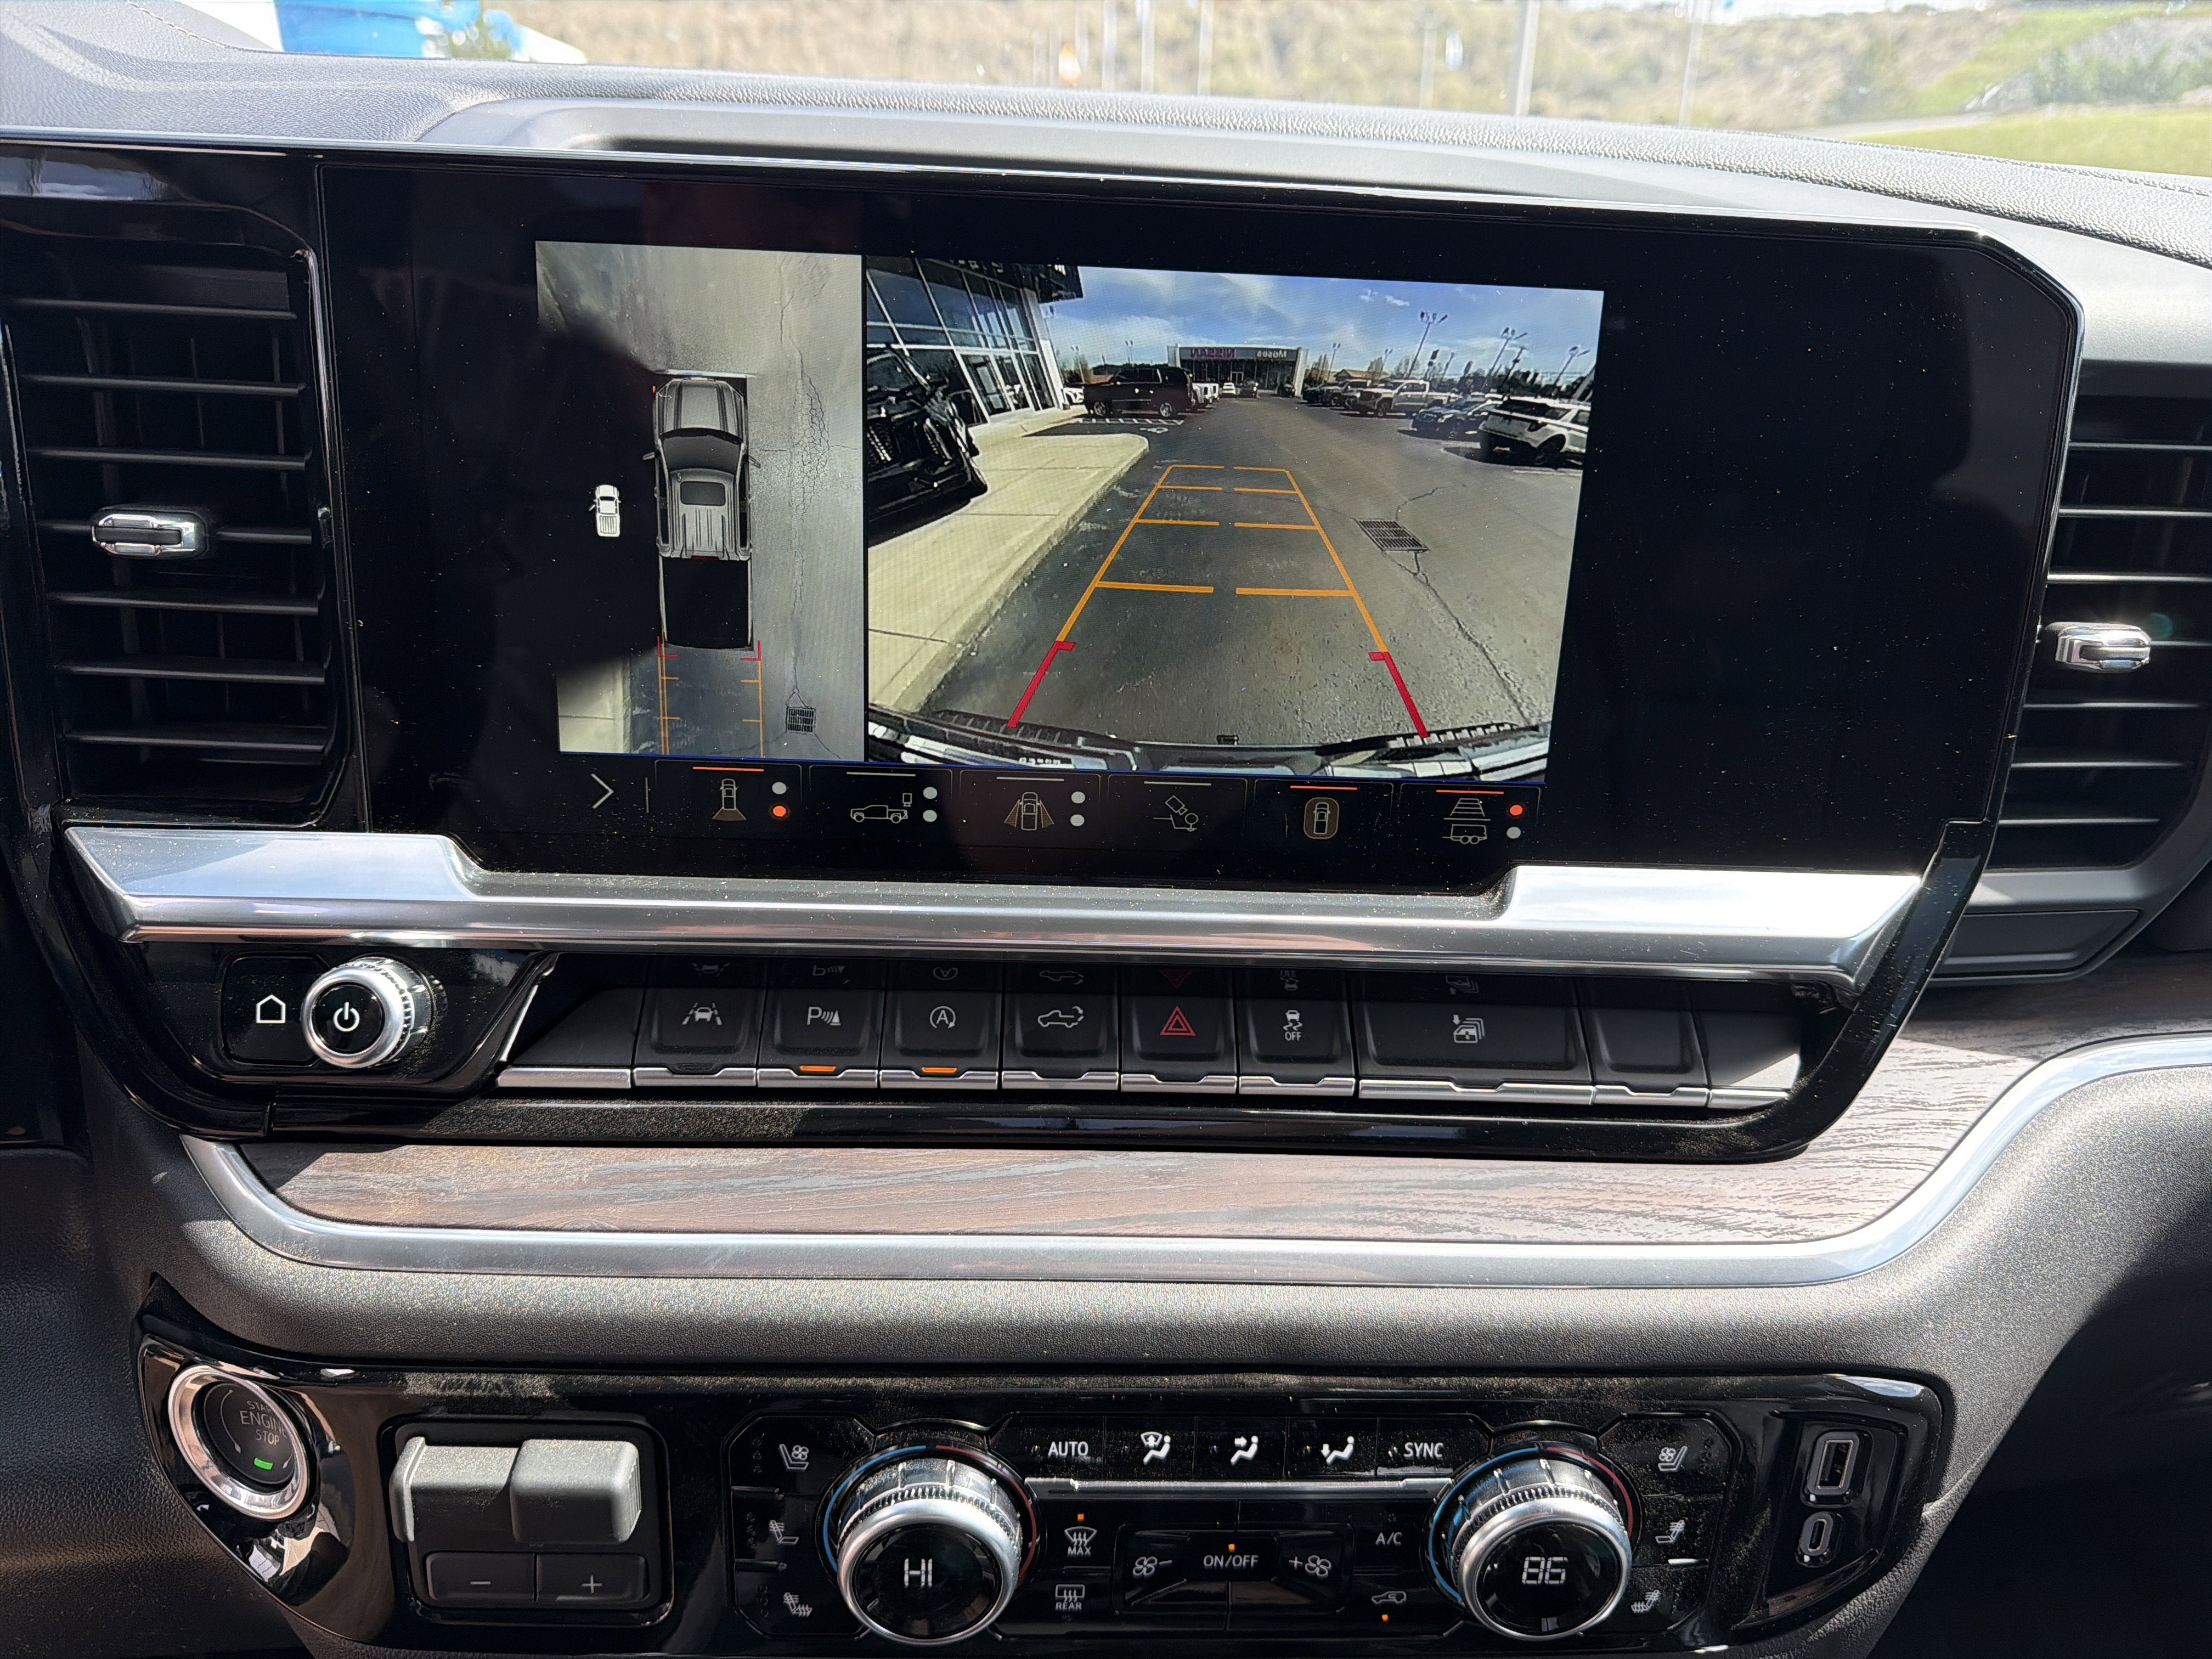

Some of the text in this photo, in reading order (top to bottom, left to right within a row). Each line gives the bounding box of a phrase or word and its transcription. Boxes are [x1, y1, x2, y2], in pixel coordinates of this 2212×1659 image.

[1284, 1031, 1302, 1041] OFF
[240, 1410, 287, 1438] ENGINE
[255, 1429, 280, 1446] STOP
[1048, 1441, 1088, 1457] AUTO
[1403, 1442, 1444, 1458] SYNC
[1375, 1532, 1402, 1545] A/C
[1067, 1545, 1091, 1556] MAX
[1203, 1555, 1259, 1568] ON/OFF
[904, 1558, 933, 1588] HI
[1521, 1556, 1568, 1584] 86
[1055, 1601, 1082, 1611] REAR
